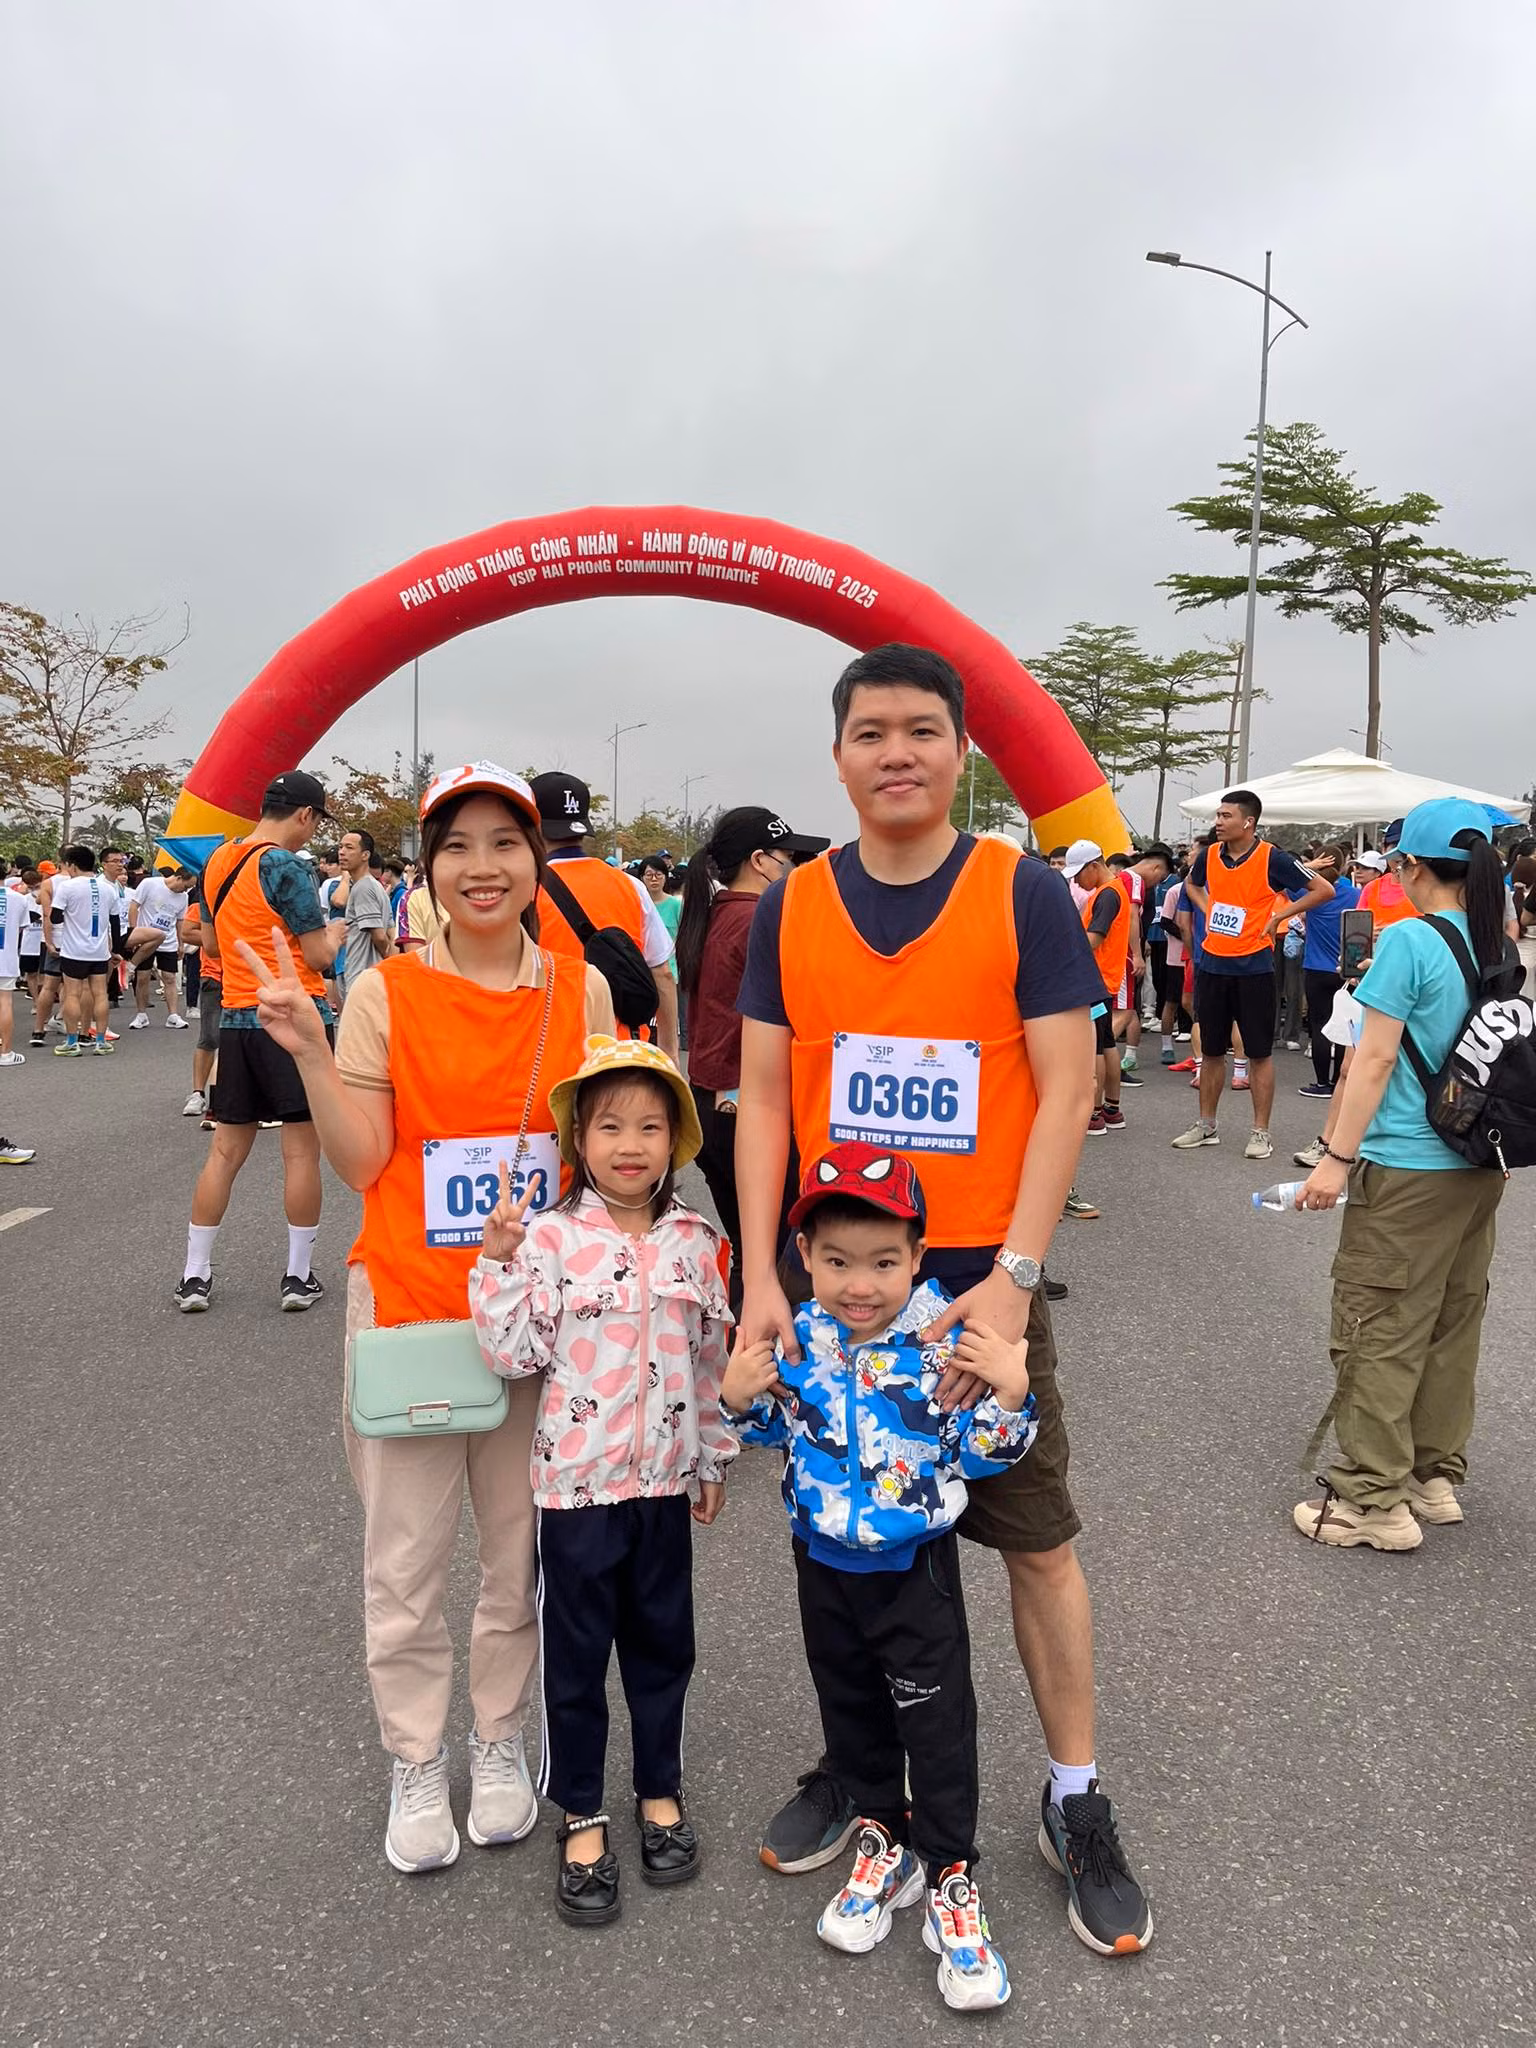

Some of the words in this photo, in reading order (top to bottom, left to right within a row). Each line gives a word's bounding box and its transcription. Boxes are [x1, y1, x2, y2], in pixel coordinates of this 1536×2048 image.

[399, 575, 437, 611] PHÁT
[436, 562, 478, 593] ĐỘNG
[477, 546, 525, 578] THÁNG
[530, 536, 571, 563] CÔNG
[577, 530, 618, 556] NHÂN
[642, 528, 682, 554] HÀNH
[687, 531, 728, 560] ĐỘNG
[748, 543, 778, 571] MÔI
[778, 553, 837, 590] TRƯỜNG
[837, 575, 880, 609] 2025
[508, 567, 538, 588] VSIP
[541, 562, 565, 580] HAI
[567, 559, 612, 576] PHONG
[615, 558, 693, 575] COMMUNITY
[697, 562, 760, 586] INITIATIVE
[563, 790, 580, 814] LA
[1212, 912, 1238, 929] 0332
[848, 1071, 959, 1123] 0366
[835, 1127, 858, 1140] 5000
[860, 1131, 892, 1144] STEPS
[894, 1135, 909, 1145] OF
[911, 1136, 969, 1149] HAPPINESS
[434, 1232, 461, 1243] 5000
[463, 1230, 484, 1241] STE
